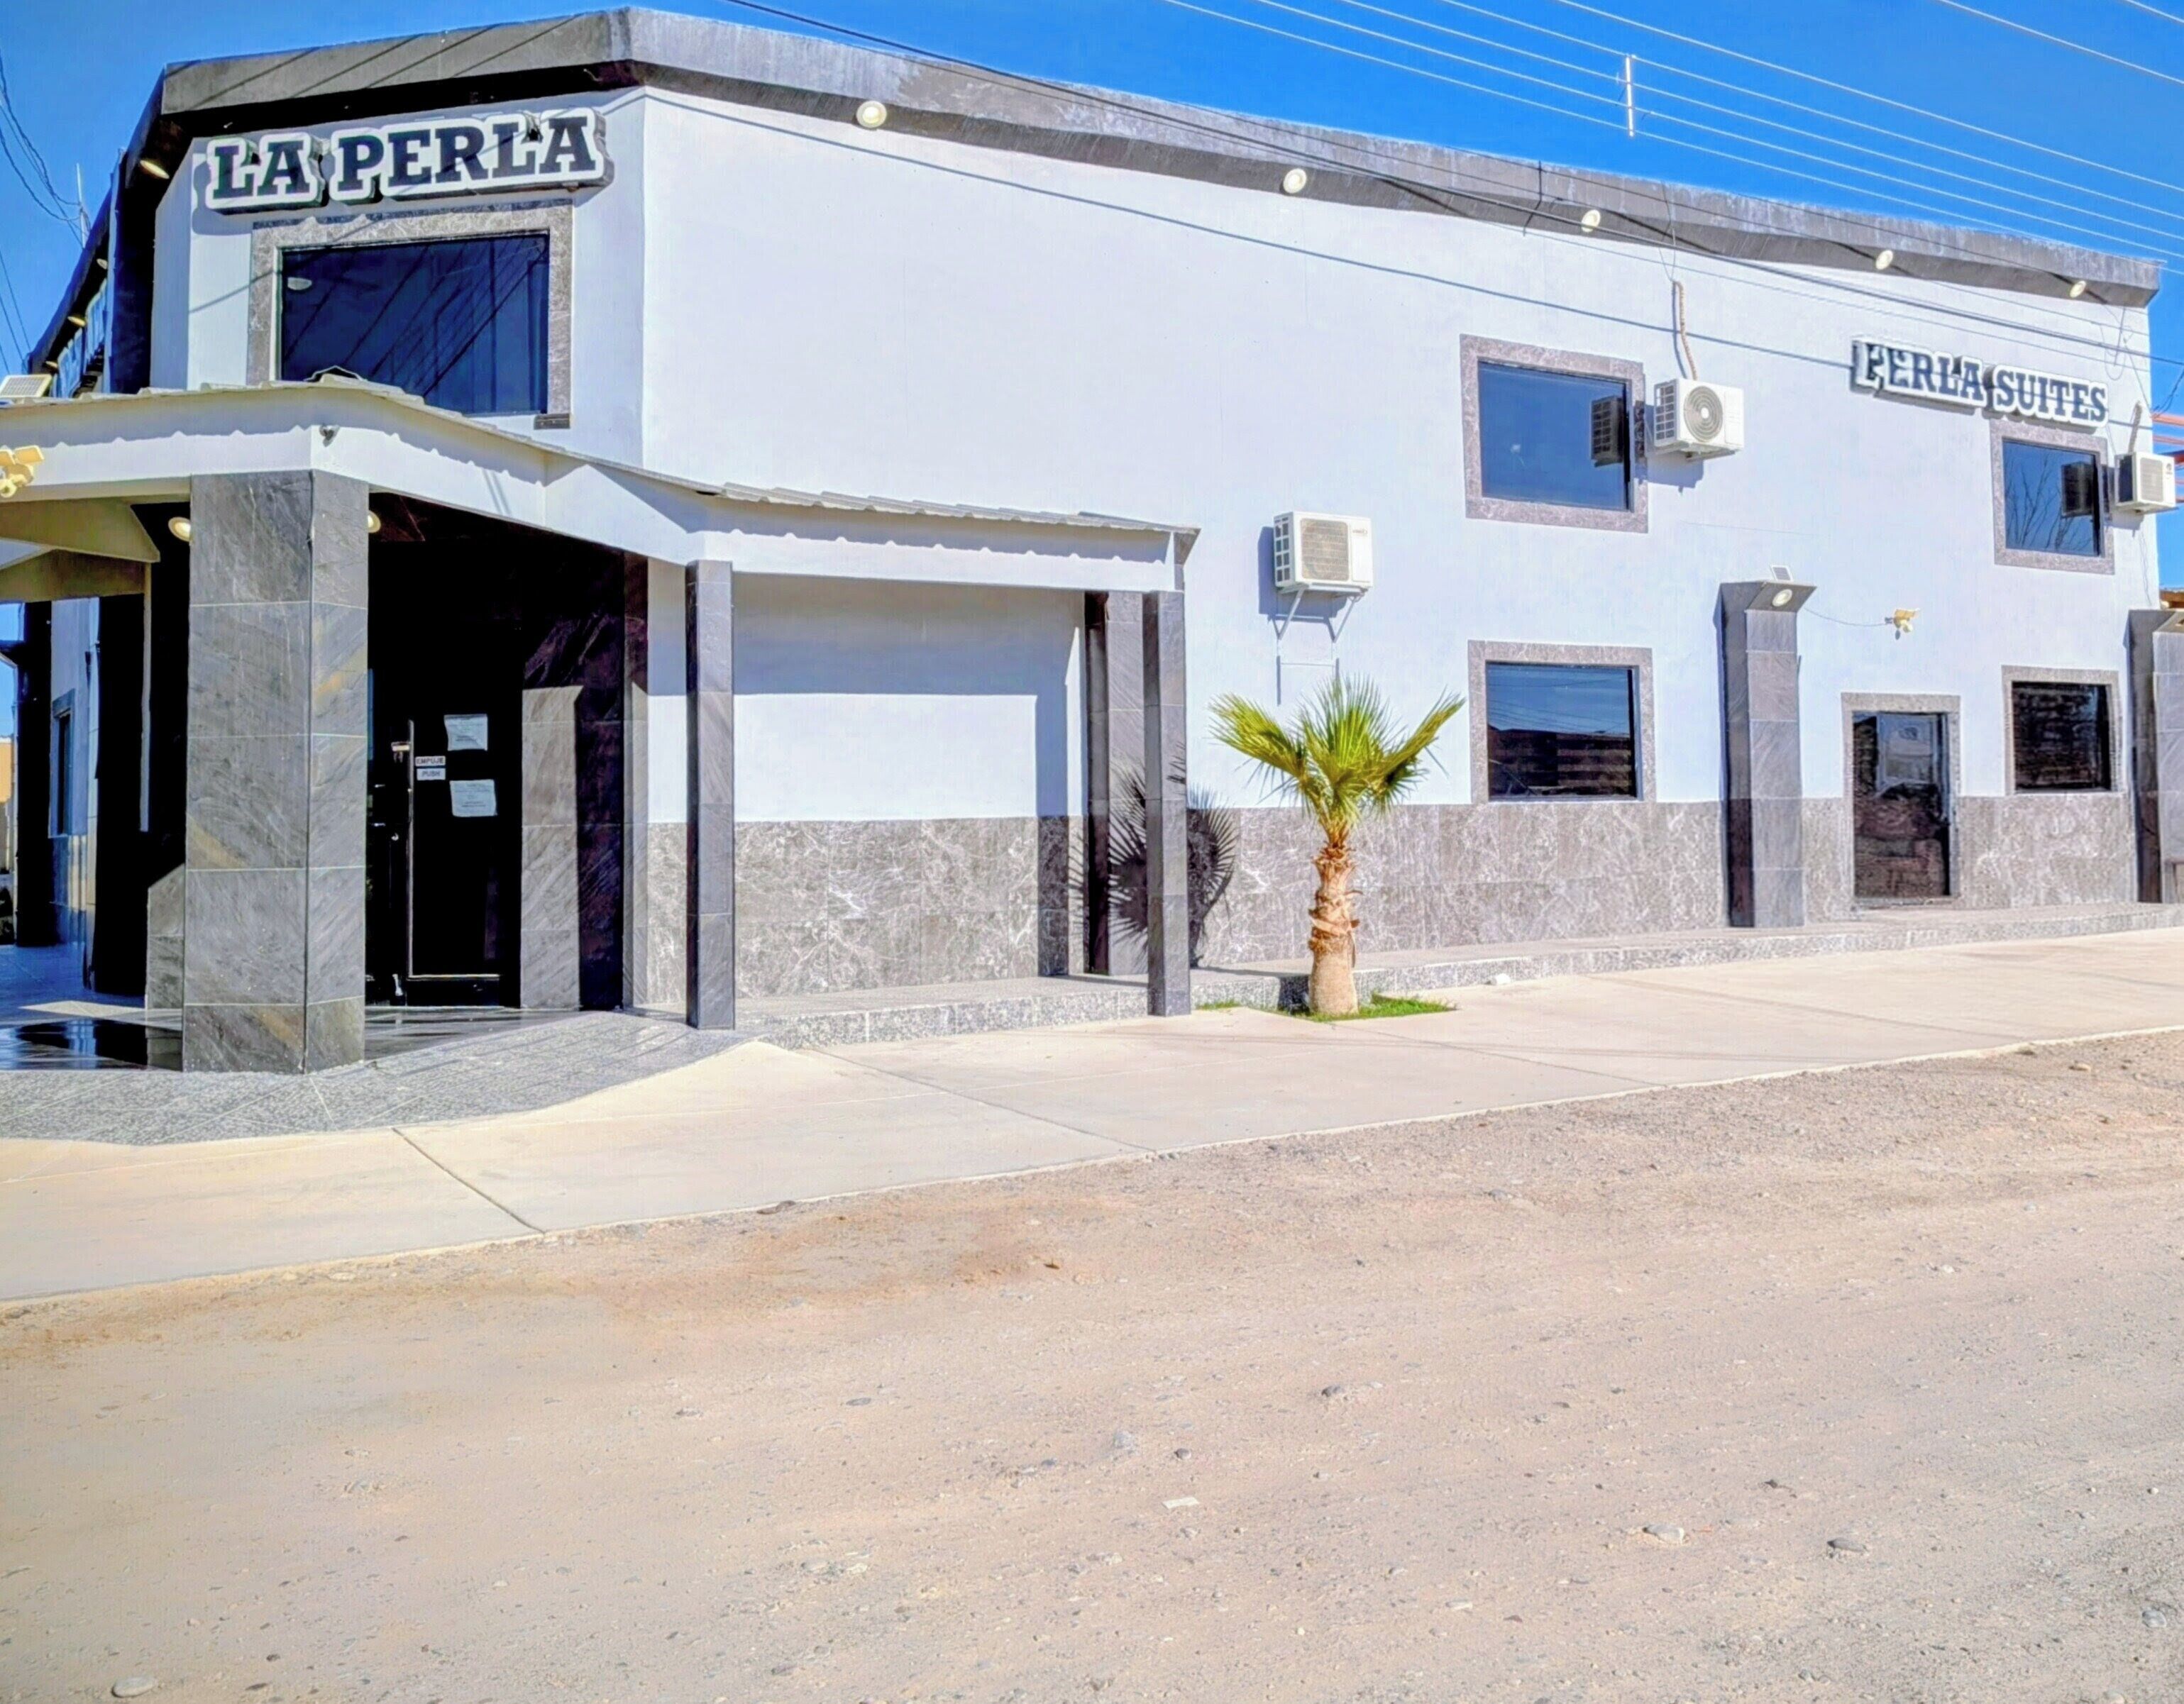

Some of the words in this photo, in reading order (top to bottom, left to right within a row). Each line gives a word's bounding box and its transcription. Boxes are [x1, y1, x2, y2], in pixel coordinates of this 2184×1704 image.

[213, 140, 310, 200] LA
[336, 116, 597, 192] PERLA
[1866, 343, 1984, 402] PERLA
[1996, 370, 2107, 423] SUITES
